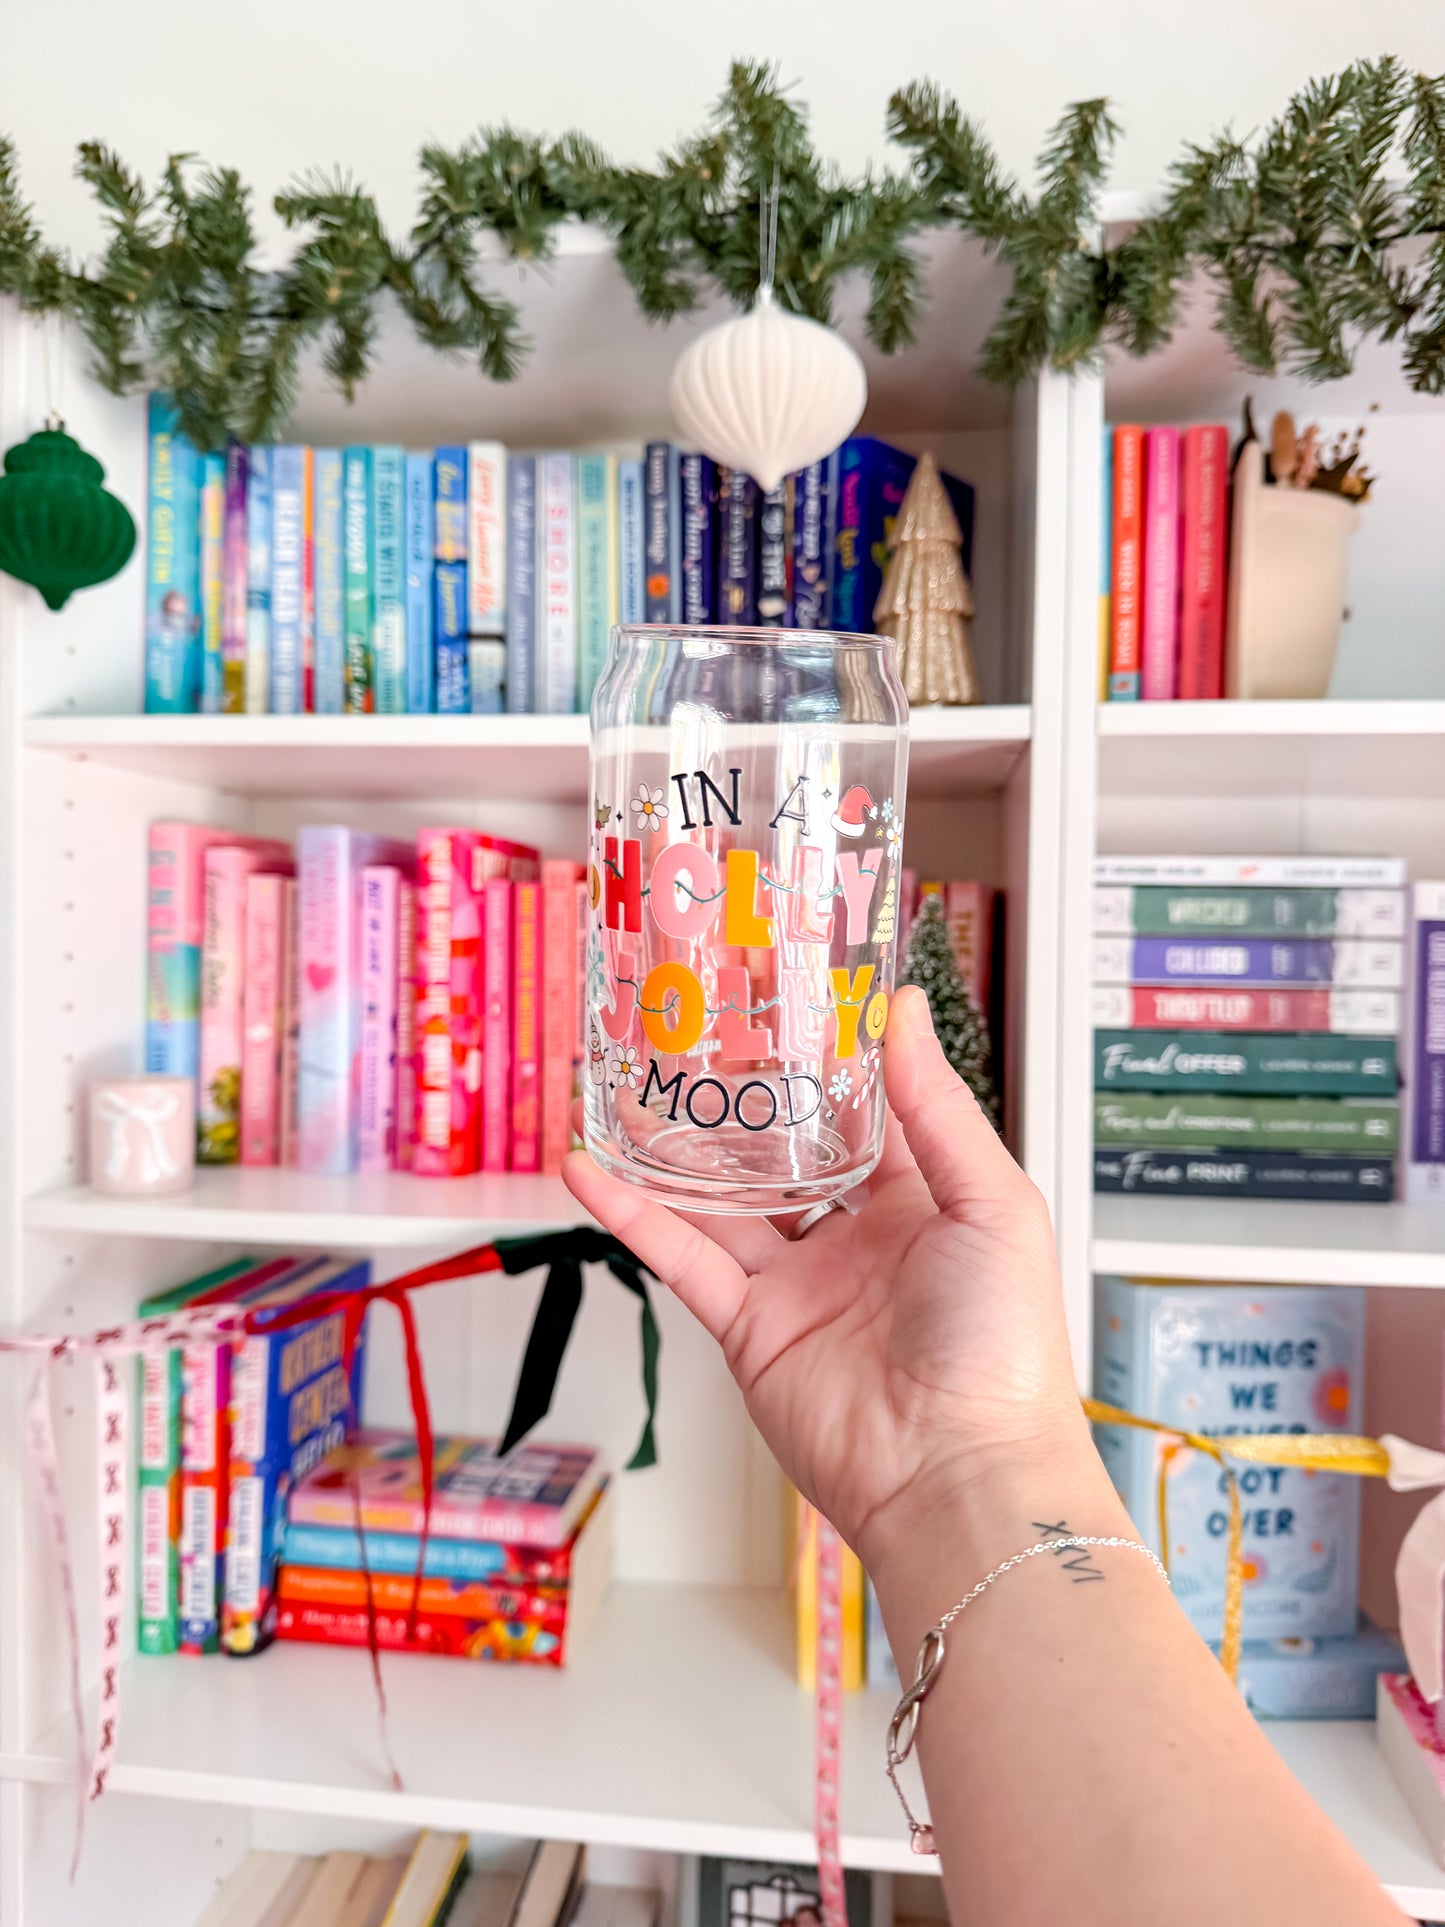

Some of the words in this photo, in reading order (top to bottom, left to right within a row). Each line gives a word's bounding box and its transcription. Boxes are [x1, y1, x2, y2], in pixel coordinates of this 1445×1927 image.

[275, 489, 299, 563] BEACH
[1118, 541, 1136, 592] WHEN
[275, 568, 299, 623] READ
[1119, 596, 1135, 614] IN
[1117, 618, 1134, 665] ROME
[671, 768, 742, 830] IN
[769, 776, 809, 836] A
[604, 837, 884, 948] HOLLY
[1167, 897, 1250, 926] WRECKED
[1165, 946, 1249, 975] COLLIDED
[599, 952, 876, 1061] JOLLY
[1103, 1043, 1182, 1080] Final
[1175, 1054, 1246, 1075] OFFER
[638, 1058, 823, 1132] MOOD
[1122, 1152, 1183, 1189] Fine
[1186, 1164, 1249, 1184] PRINT
[1195, 1339, 1317, 1368] THINGS
[1229, 1382, 1278, 1410] WE
